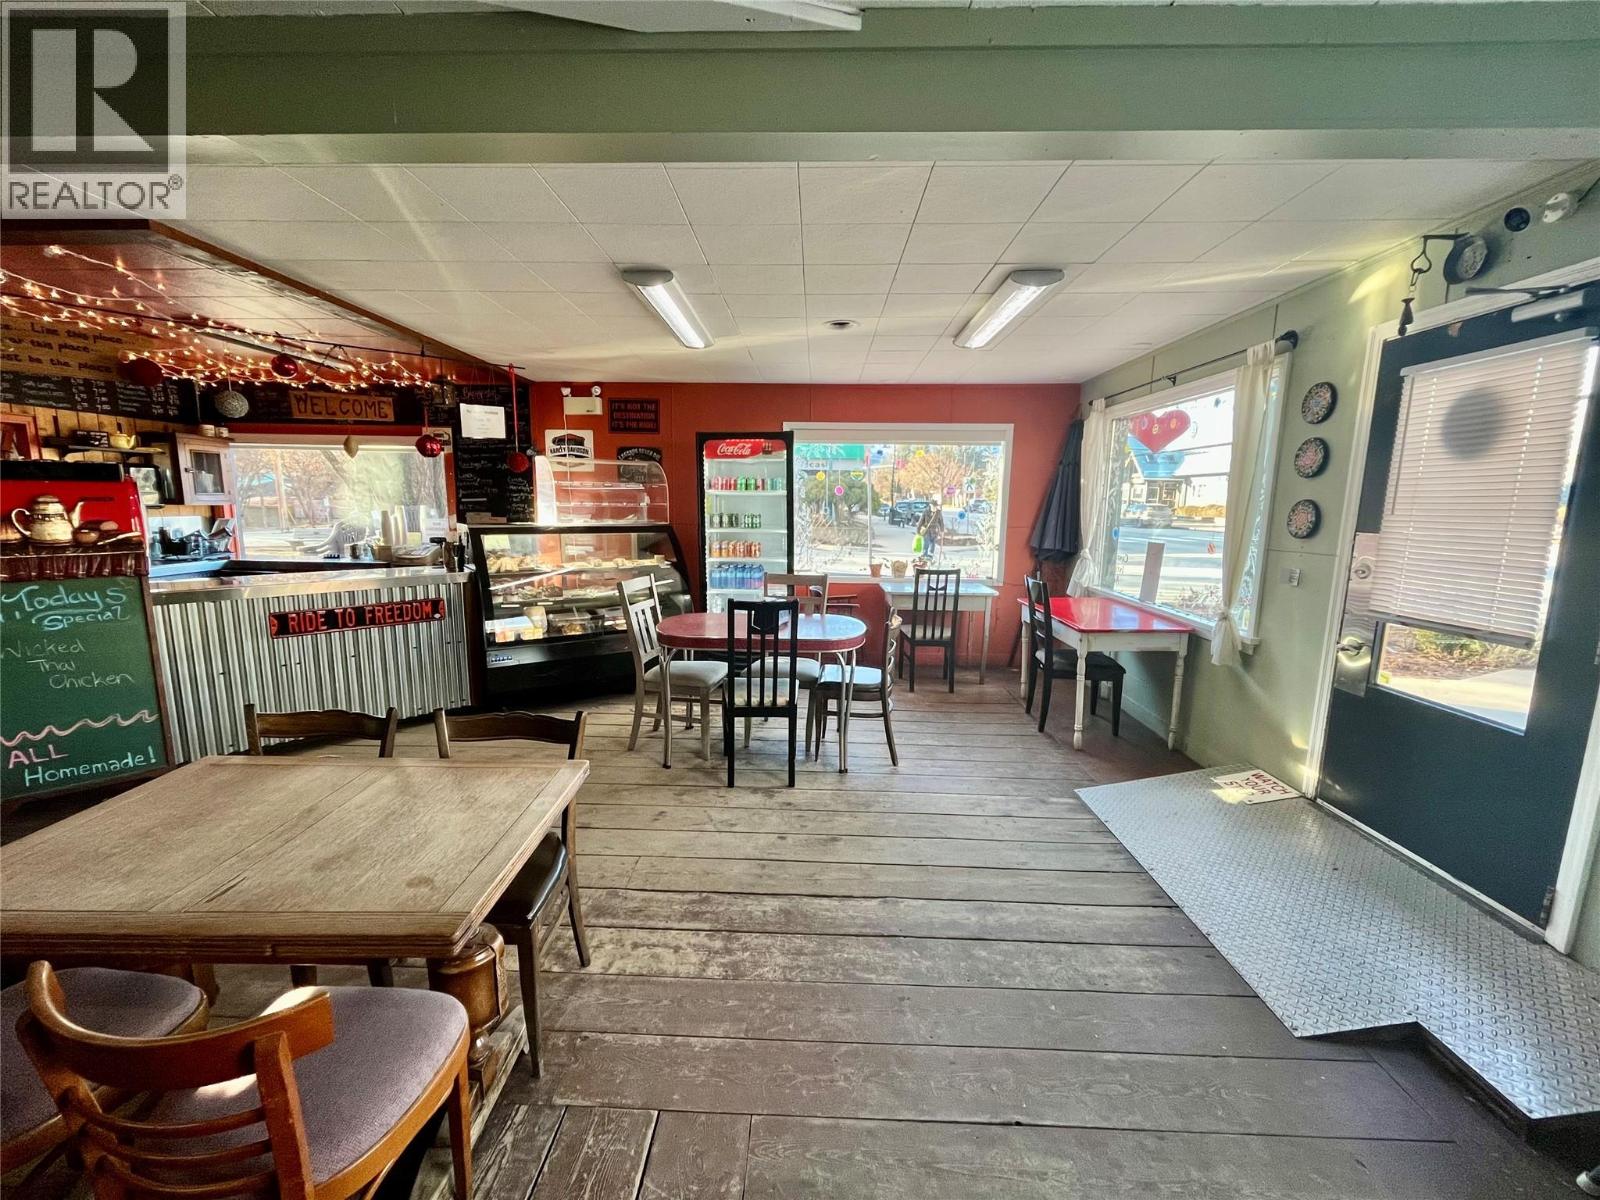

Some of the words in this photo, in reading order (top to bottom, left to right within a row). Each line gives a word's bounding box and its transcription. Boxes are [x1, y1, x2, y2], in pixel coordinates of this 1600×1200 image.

[294, 393, 389, 419] WELCOME
[43, 605, 130, 631] Special
[288, 610, 328, 634] RIDE
[334, 608, 356, 628] TO
[364, 601, 433, 626] FREEDOM
[50, 672, 135, 689] Chicken
[8, 744, 69, 769] ALL
[24, 745, 157, 787] Homemade!
[1251, 772, 1291, 795] WATCH
